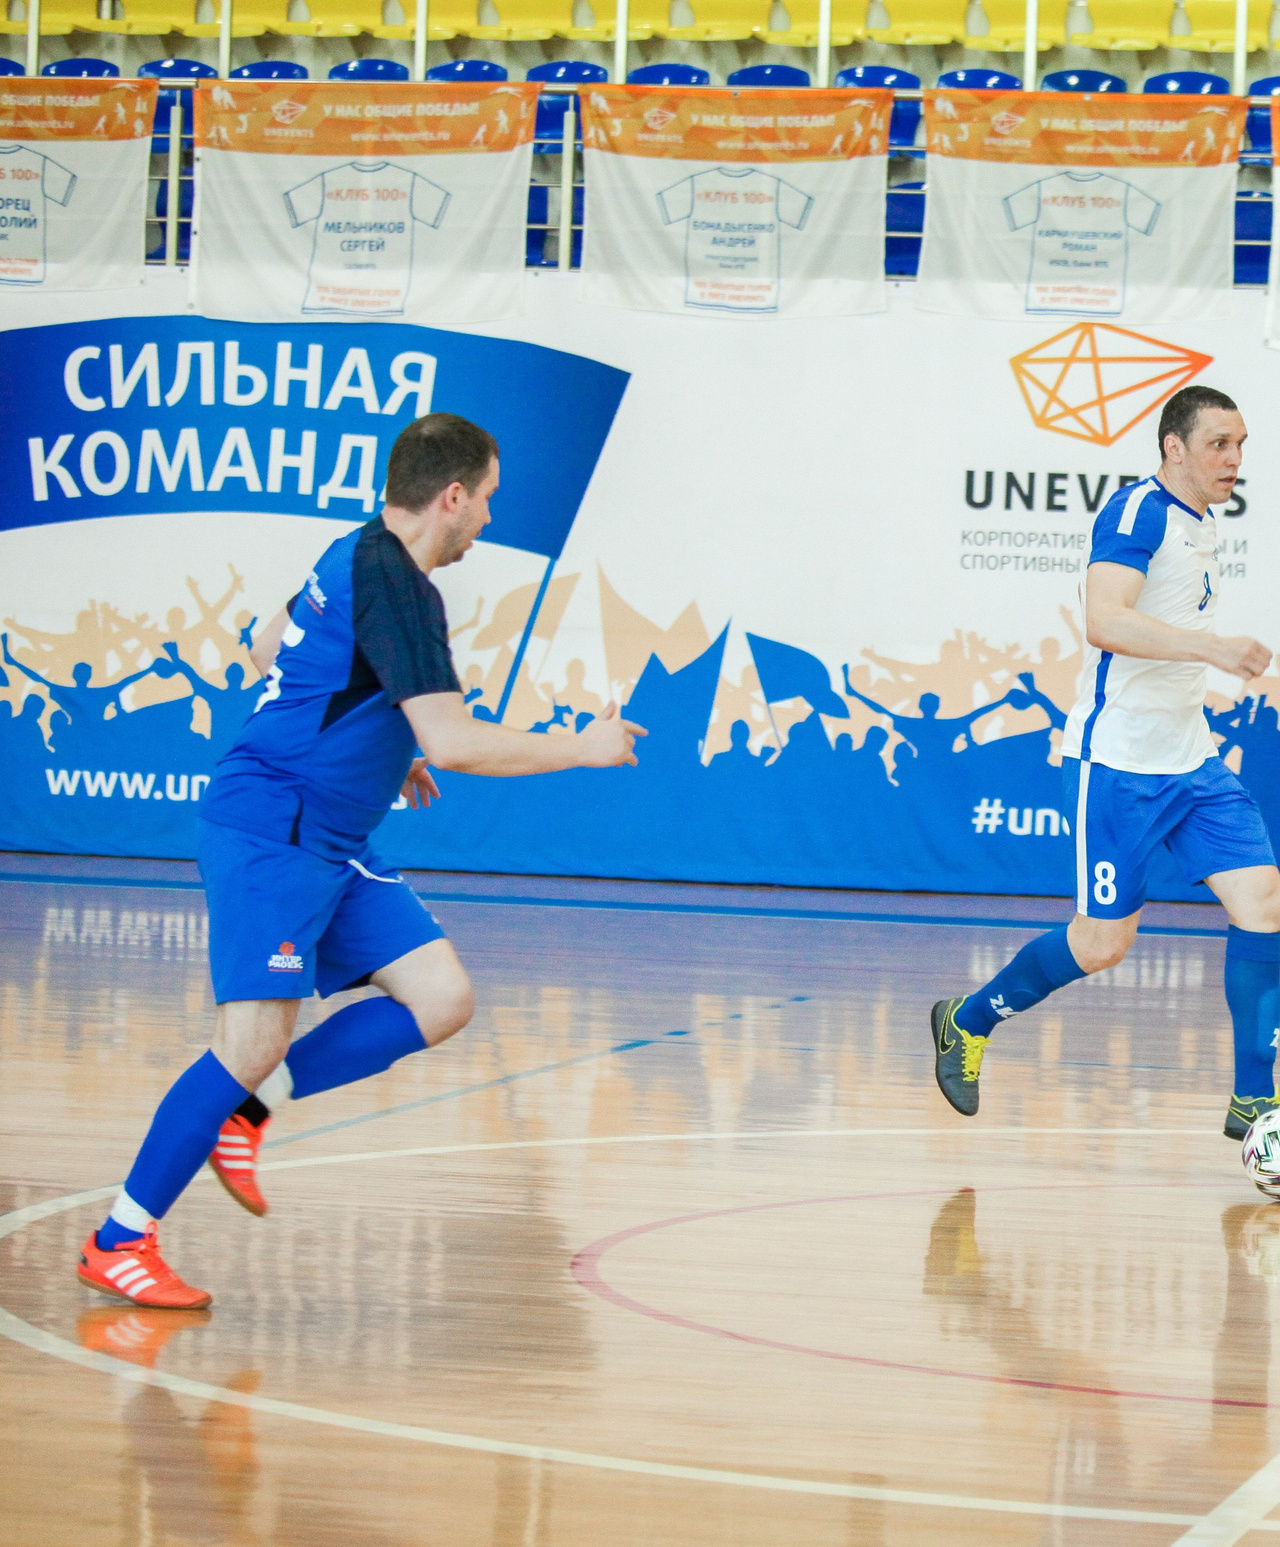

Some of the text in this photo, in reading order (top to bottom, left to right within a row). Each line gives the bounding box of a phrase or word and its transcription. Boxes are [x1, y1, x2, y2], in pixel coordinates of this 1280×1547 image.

[323, 103, 332, 116] У
[335, 104, 362, 117] НАС
[364, 103, 413, 118] ОБЩИЕ
[691, 114, 699, 124] У
[702, 115, 727, 126] НАС
[729, 115, 774, 128] ОБЩИЕ
[1040, 118, 1048, 129] У
[1050, 118, 1077, 131] НАС
[1079, 118, 1125, 132] ОБЩИЕ
[323, 222, 405, 234] МЕЛЬНИКОВ
[340, 238, 385, 252] СЕРГЕЙ
[64, 341, 437, 419] СИЛЬНАЯ
[28, 427, 386, 513] КОМАНД
[965, 470, 1247, 518] UNEVS
[961, 530, 1087, 550] КОРПОРАТИВ
[960, 554, 1081, 574] СПОРТИВНЫ
[1093, 861, 1117, 906] 8
